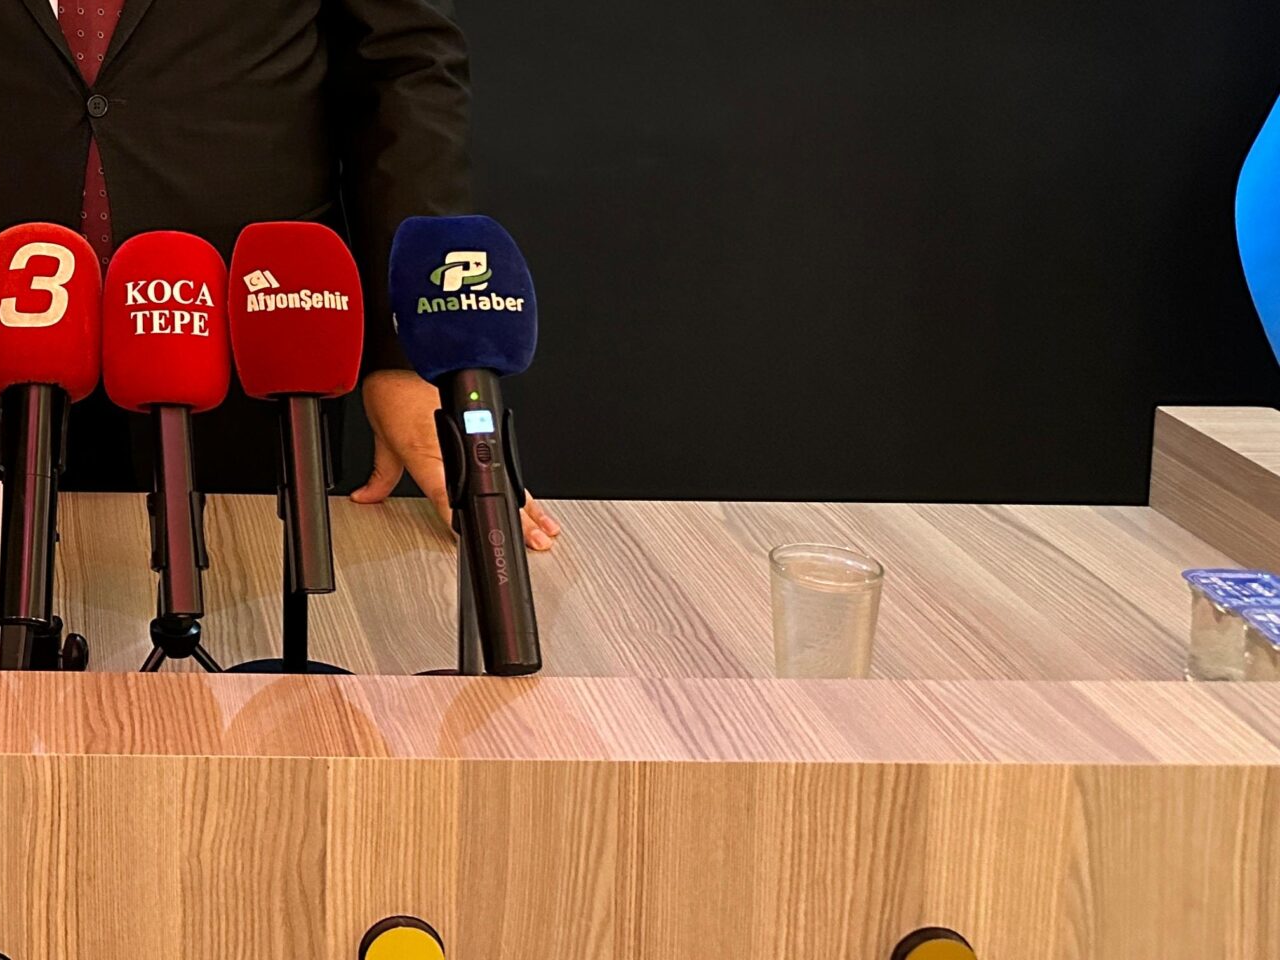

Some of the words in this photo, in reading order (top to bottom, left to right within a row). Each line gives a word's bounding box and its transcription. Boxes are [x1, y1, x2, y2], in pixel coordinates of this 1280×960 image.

[124, 279, 215, 308] KOCA
[247, 289, 349, 313] AfyonŞehir
[417, 293, 525, 314] AnaHaber
[130, 309, 210, 338] TEPE
[494, 547, 509, 586] BOYA
